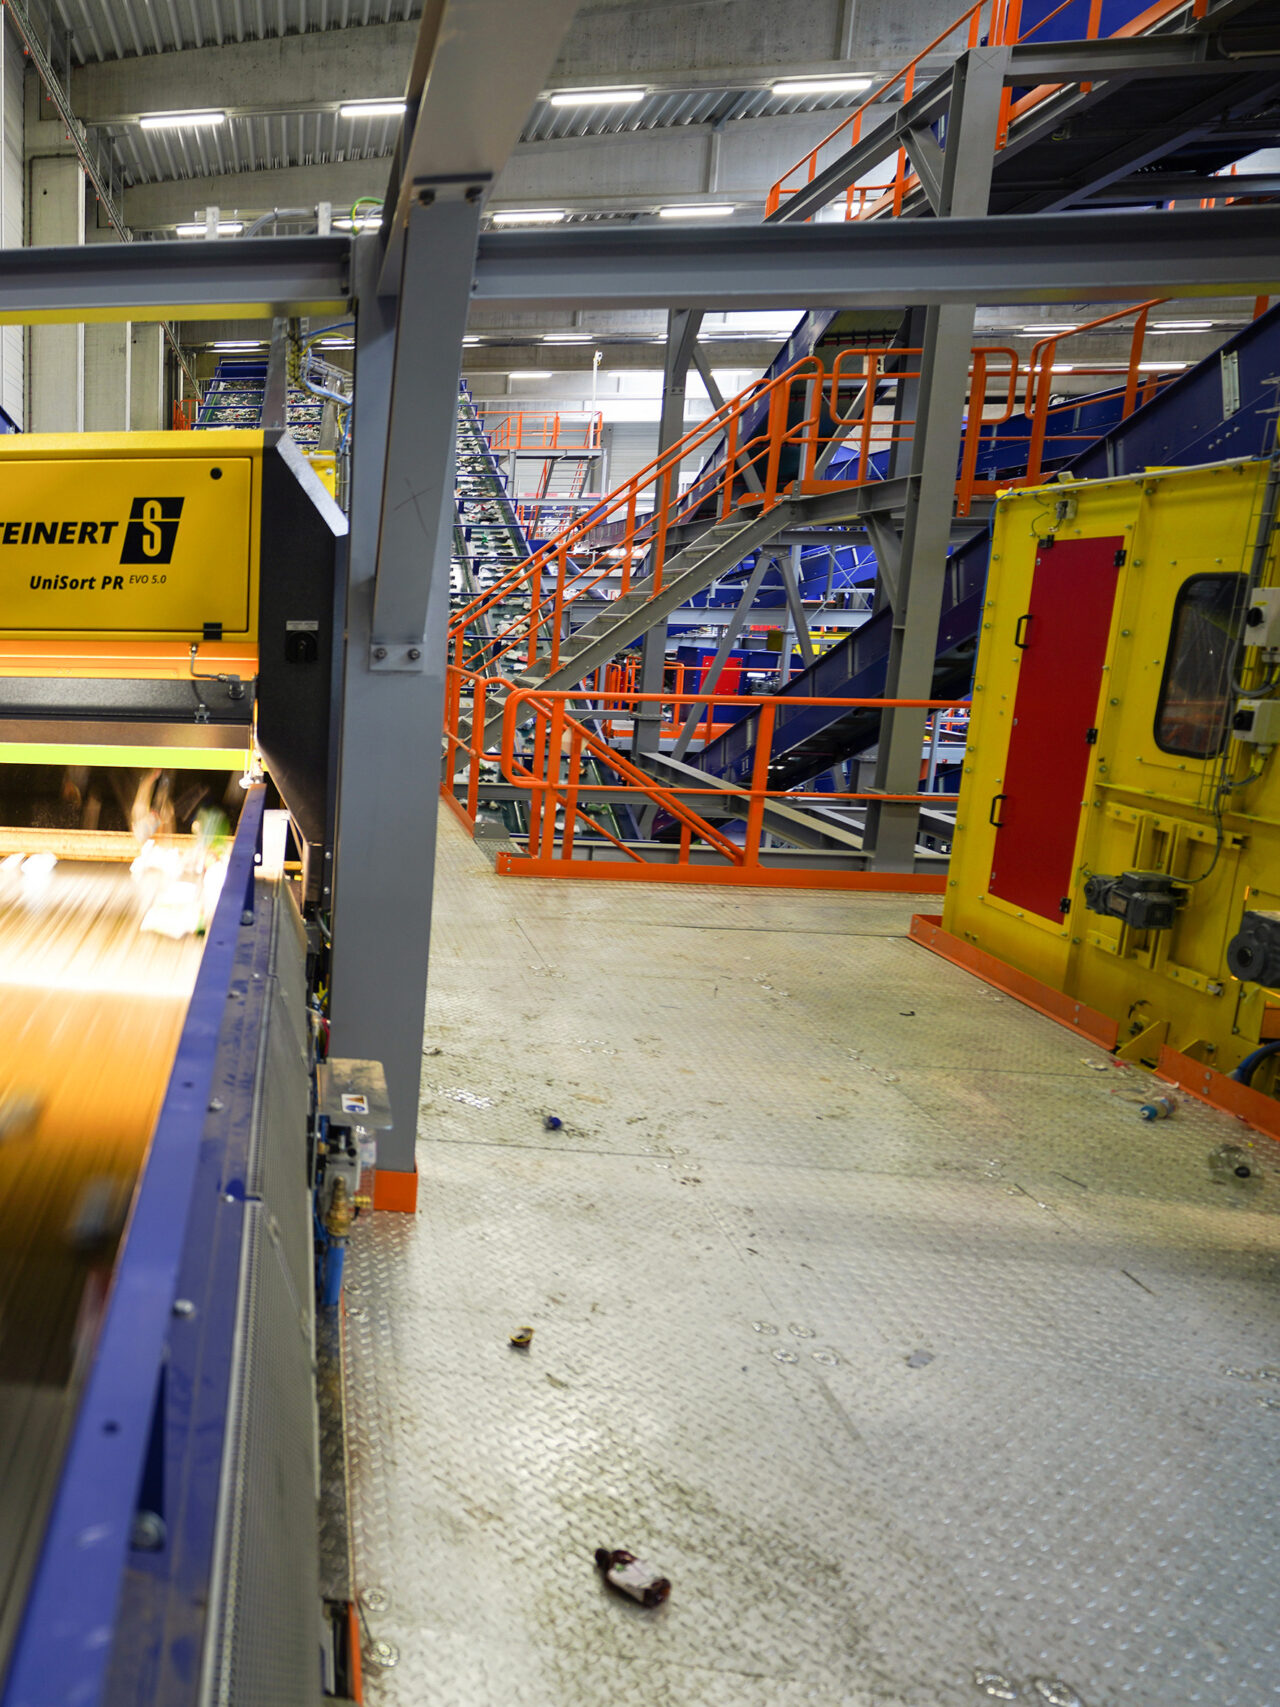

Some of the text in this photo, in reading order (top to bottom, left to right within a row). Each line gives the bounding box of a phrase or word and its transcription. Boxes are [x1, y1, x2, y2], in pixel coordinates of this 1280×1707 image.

[29, 575, 167, 590] UniSort PR EVO 5.0
